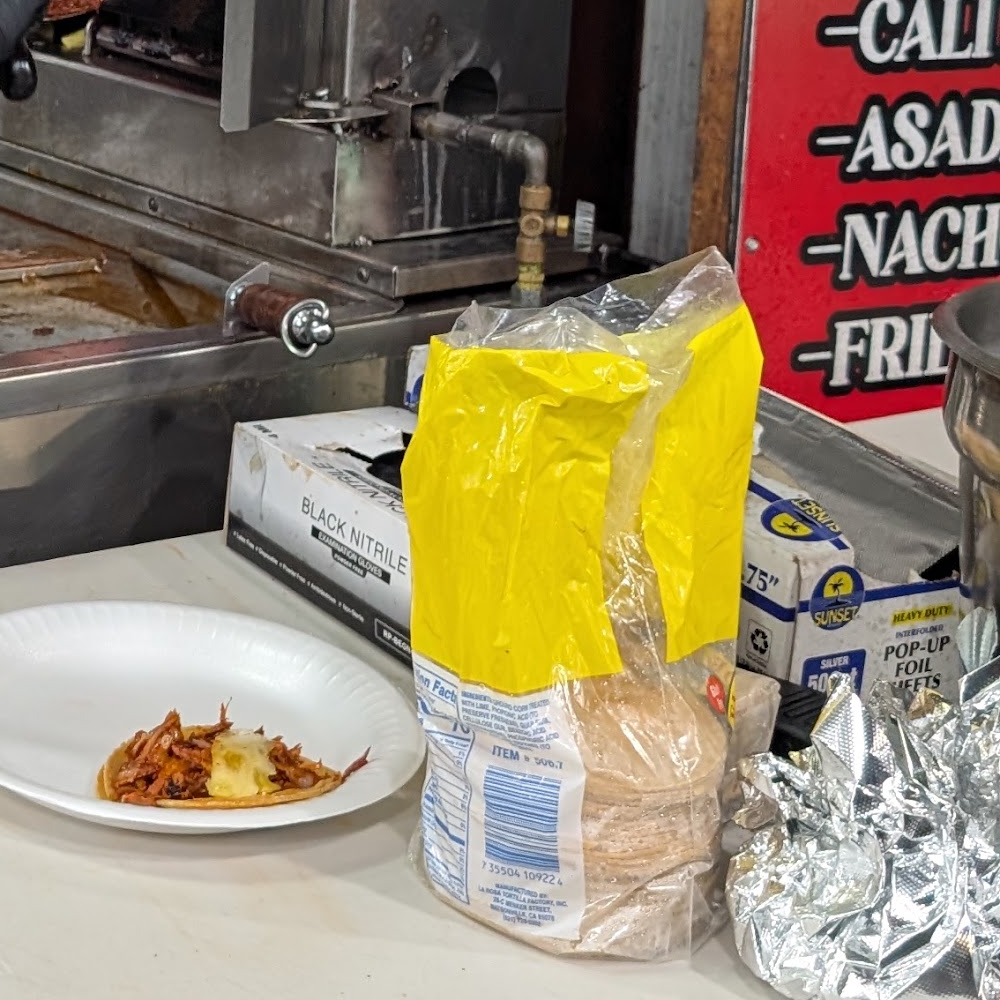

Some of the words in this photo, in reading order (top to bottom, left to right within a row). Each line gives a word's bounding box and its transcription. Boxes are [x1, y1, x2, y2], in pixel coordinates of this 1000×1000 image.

[301, 496, 346, 539] BLACK
[350, 526, 408, 576] NITRILE
[318, 531, 358, 563] EXAMINATION
[358, 557, 383, 577] GLOVES
[813, 605, 859, 626] SUNSET
[893, 610, 923, 624] HEAVY
[924, 605, 949, 618] DUTY
[884, 635, 950, 661] POP-UP
[820, 655, 849, 669] SILVER
[895, 657, 933, 677] FOIL
[492, 744, 520, 761] ITEM
[488, 863, 521, 878] 35504
[523, 870, 555, 885] 10922
